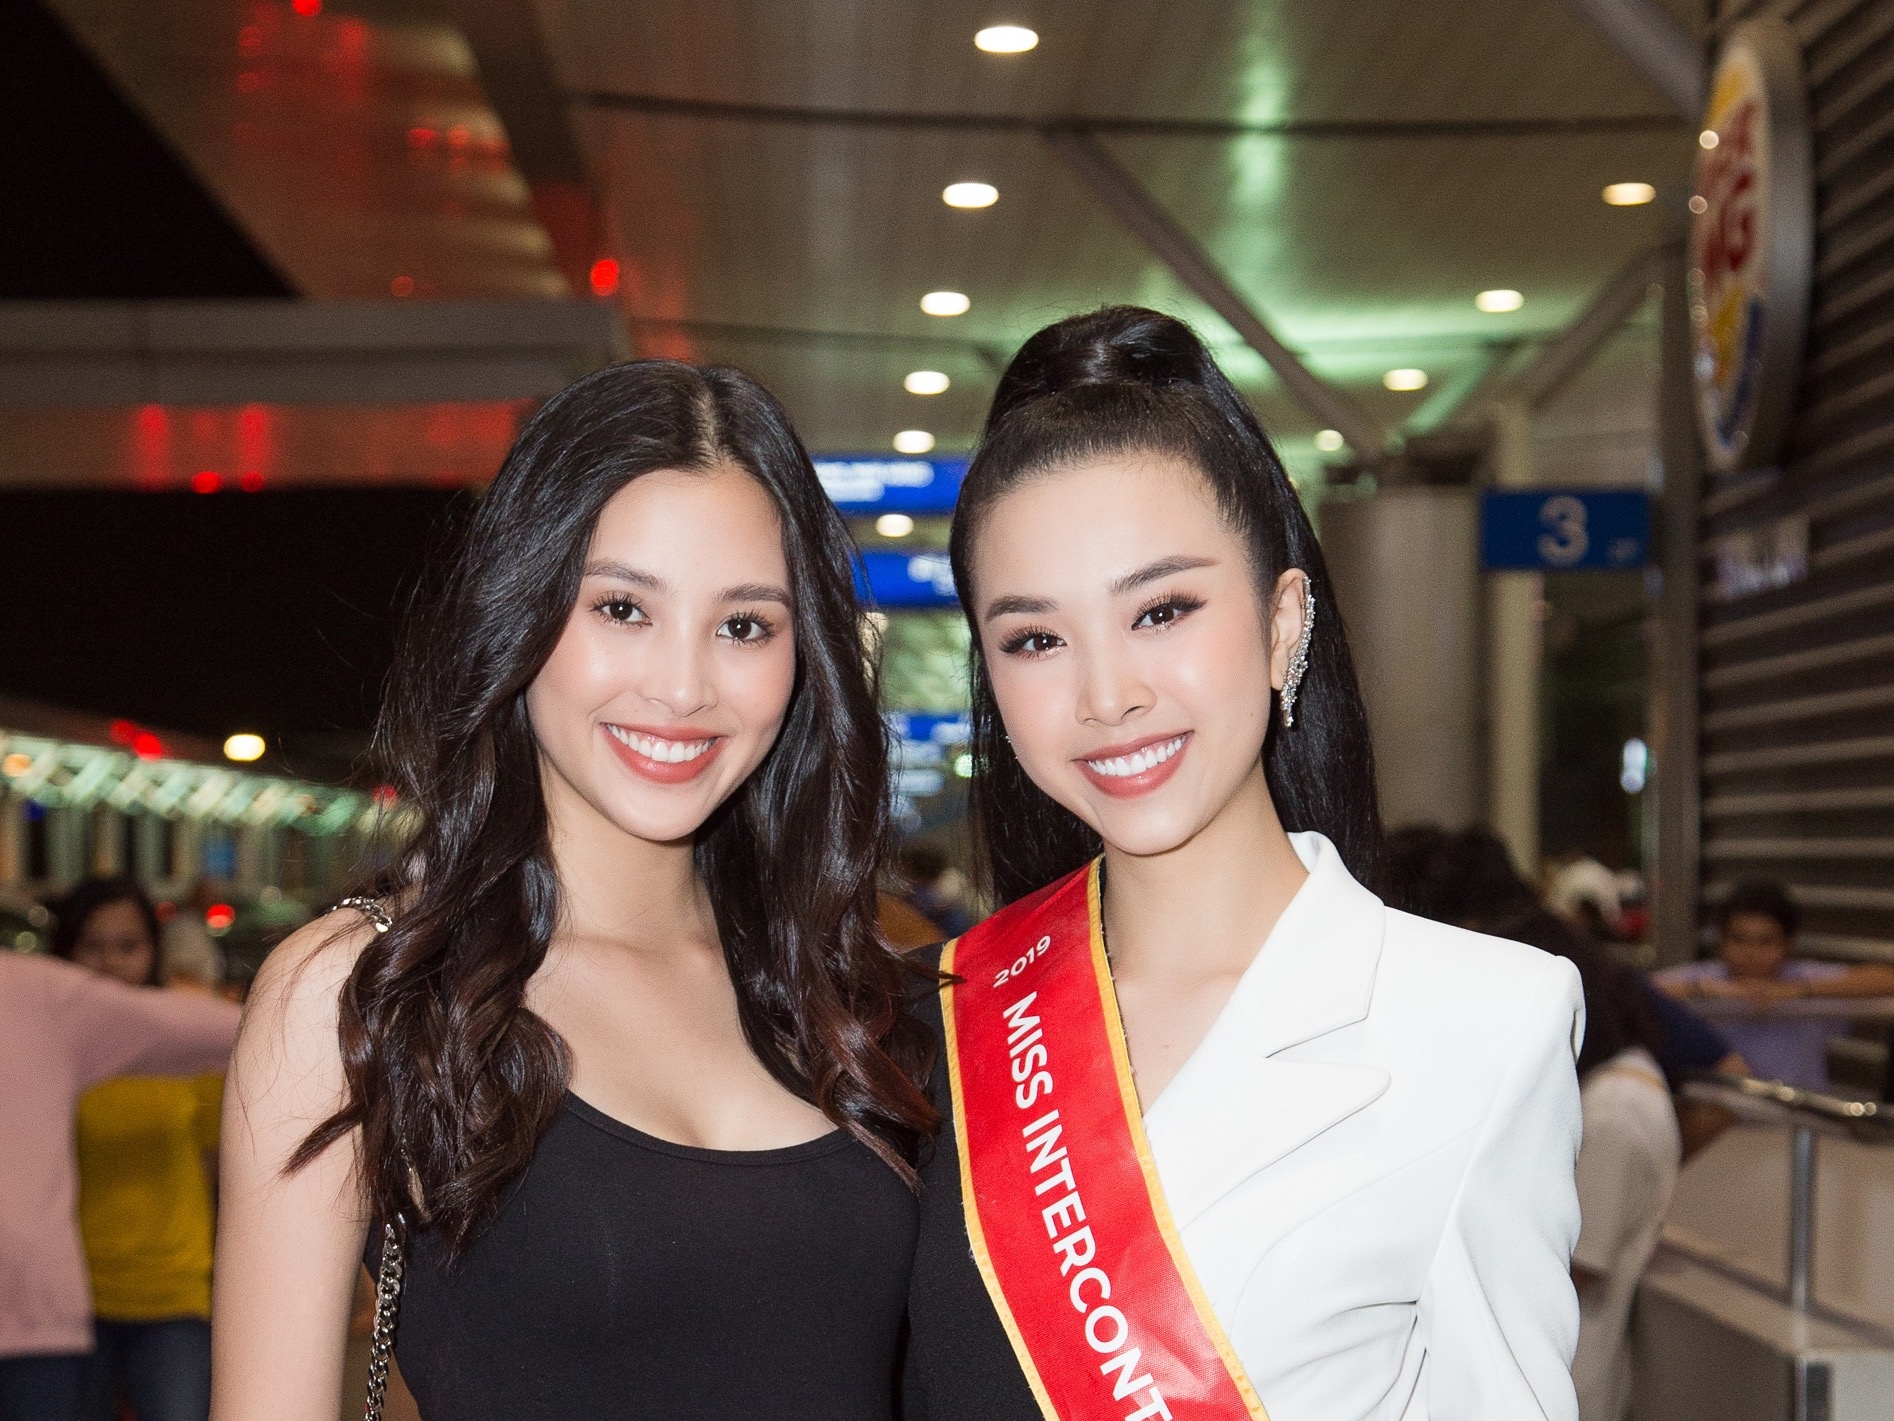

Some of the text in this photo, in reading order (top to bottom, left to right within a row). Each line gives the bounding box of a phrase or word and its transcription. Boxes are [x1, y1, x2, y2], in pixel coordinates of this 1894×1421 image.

[1537, 495, 1589, 567] 3
[993, 935, 1051, 988] 2019
[1003, 991, 1053, 1109] MISS
